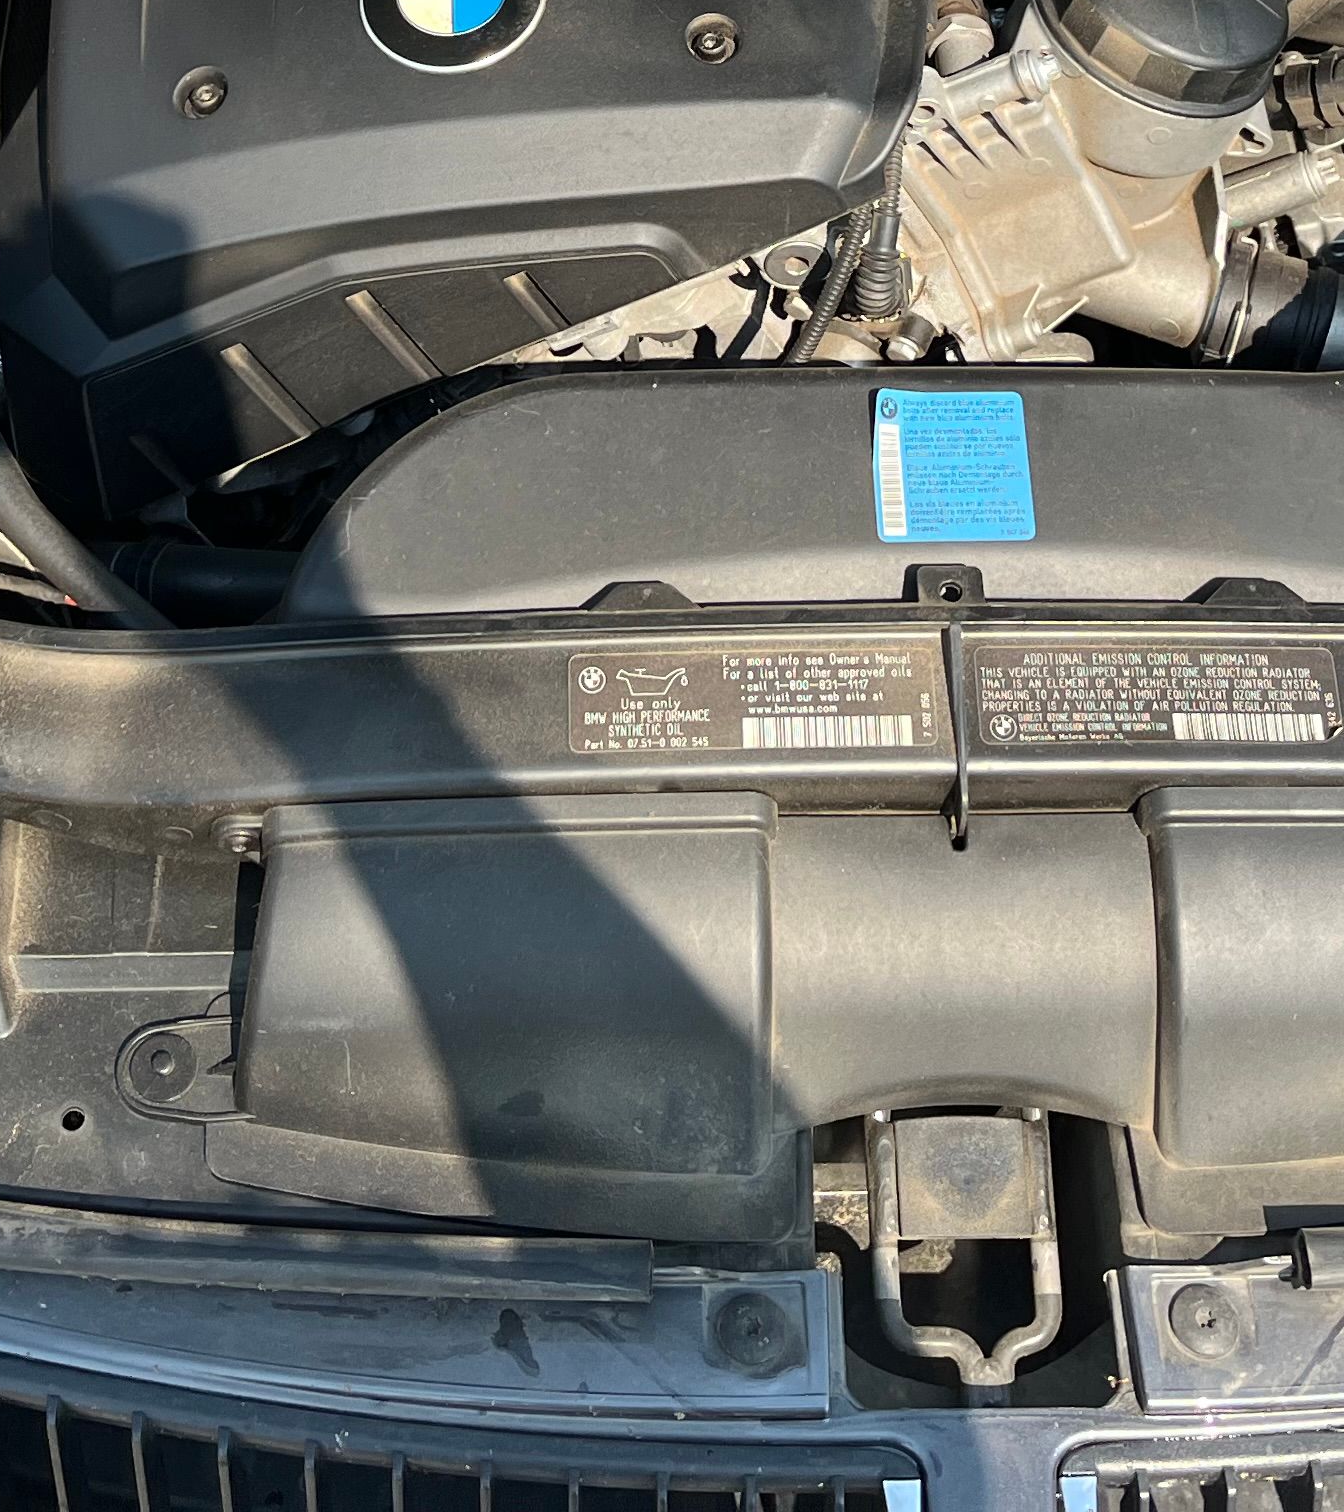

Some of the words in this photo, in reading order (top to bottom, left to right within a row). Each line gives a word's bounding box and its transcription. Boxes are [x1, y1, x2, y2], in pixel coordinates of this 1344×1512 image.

[723, 654, 743, 667] For
[746, 656, 772, 666] more
[778, 654, 799, 666] info
[806, 656, 824, 665] see
[829, 654, 869, 665] Owner's
[875, 653, 911, 665] Manual
[1024, 653, 1087, 666] ADDITIONAL
[1092, 653, 1142, 666] EMISSION
[1147, 653, 1191, 666] CONTROL
[1200, 653, 1268, 666] INFORMATION
[723, 667, 742, 679] For
[746, 670, 754, 679] a
[760, 667, 779, 679] list
[786, 667, 798, 679] of
[804, 667, 831, 679] other
[837, 667, 885, 681] approved
[890, 666, 913, 678] oils
[980, 667, 1001, 678] THIS
[1008, 667, 1050, 678] VEHICLE
[1056, 667, 1066, 678] IS
[1070, 667, 1117, 678] EQUIPPED
[1123, 667, 1148, 678] WITH
[1153, 667, 1165, 678] AN
[1171, 667, 1201, 678] OZONE
[1206, 667, 1258, 678] REDUCTION
[1262, 667, 1311, 678] RADIATOR
[981, 678, 1005, 689] THAT
[1013, 678, 1023, 689] IS
[1028, 678, 1041, 689] AN
[1047, 678, 1089, 689] ELEMENT
[1095, 678, 1107, 689] OF
[1114, 678, 1131, 689] THE
[1137, 678, 1178, 689] VEHICLE
[1184, 678, 1229, 689] EMISSION
[1234, 678, 1276, 689] CONTROL
[747, 694, 759, 703] or
[766, 692, 790, 702] visit
[796, 693, 813, 702] our
[819, 692, 840, 702] web
[846, 692, 868, 701] site
[872, 691, 884, 701] at
[982, 689, 1029, 700] CHANGING
[1035, 689, 1047, 700] TO
[1053, 689, 1060, 700] A
[1066, 689, 1113, 700] RADIATOR
[1119, 689, 1160, 700] WITHOUT
[1167, 689, 1226, 700] EQUIVALENT
[1233, 689, 1262, 700] OZONE
[1268, 689, 1320, 700] REDUCTION
[620, 699, 643, 711] Use
[652, 699, 681, 713] only
[748, 704, 838, 714] www.bmwusa.com
[982, 700, 1041, 712] PROPERTIES
[1047, 700, 1056, 712] IS
[1062, 700, 1069, 712] A
[1075, 700, 1128, 712] VIOLATION
[1134, 700, 1145, 712] OF
[1152, 700, 1169, 712] AIR
[1175, 700, 1226, 712] POLLUTION
[1232, 700, 1295, 712] REGULATION.
[584, 712, 606, 724] BMW
[612, 711, 636, 723] HIGH
[641, 710, 710, 723] PERFORMANCE
[608, 724, 663, 738] SYNTHETIC
[667, 724, 684, 736] OIL
[584, 740, 604, 750] Part
[608, 739, 623, 749] No.
[671, 738, 688, 748] 002
[692, 737, 709, 747] 545
